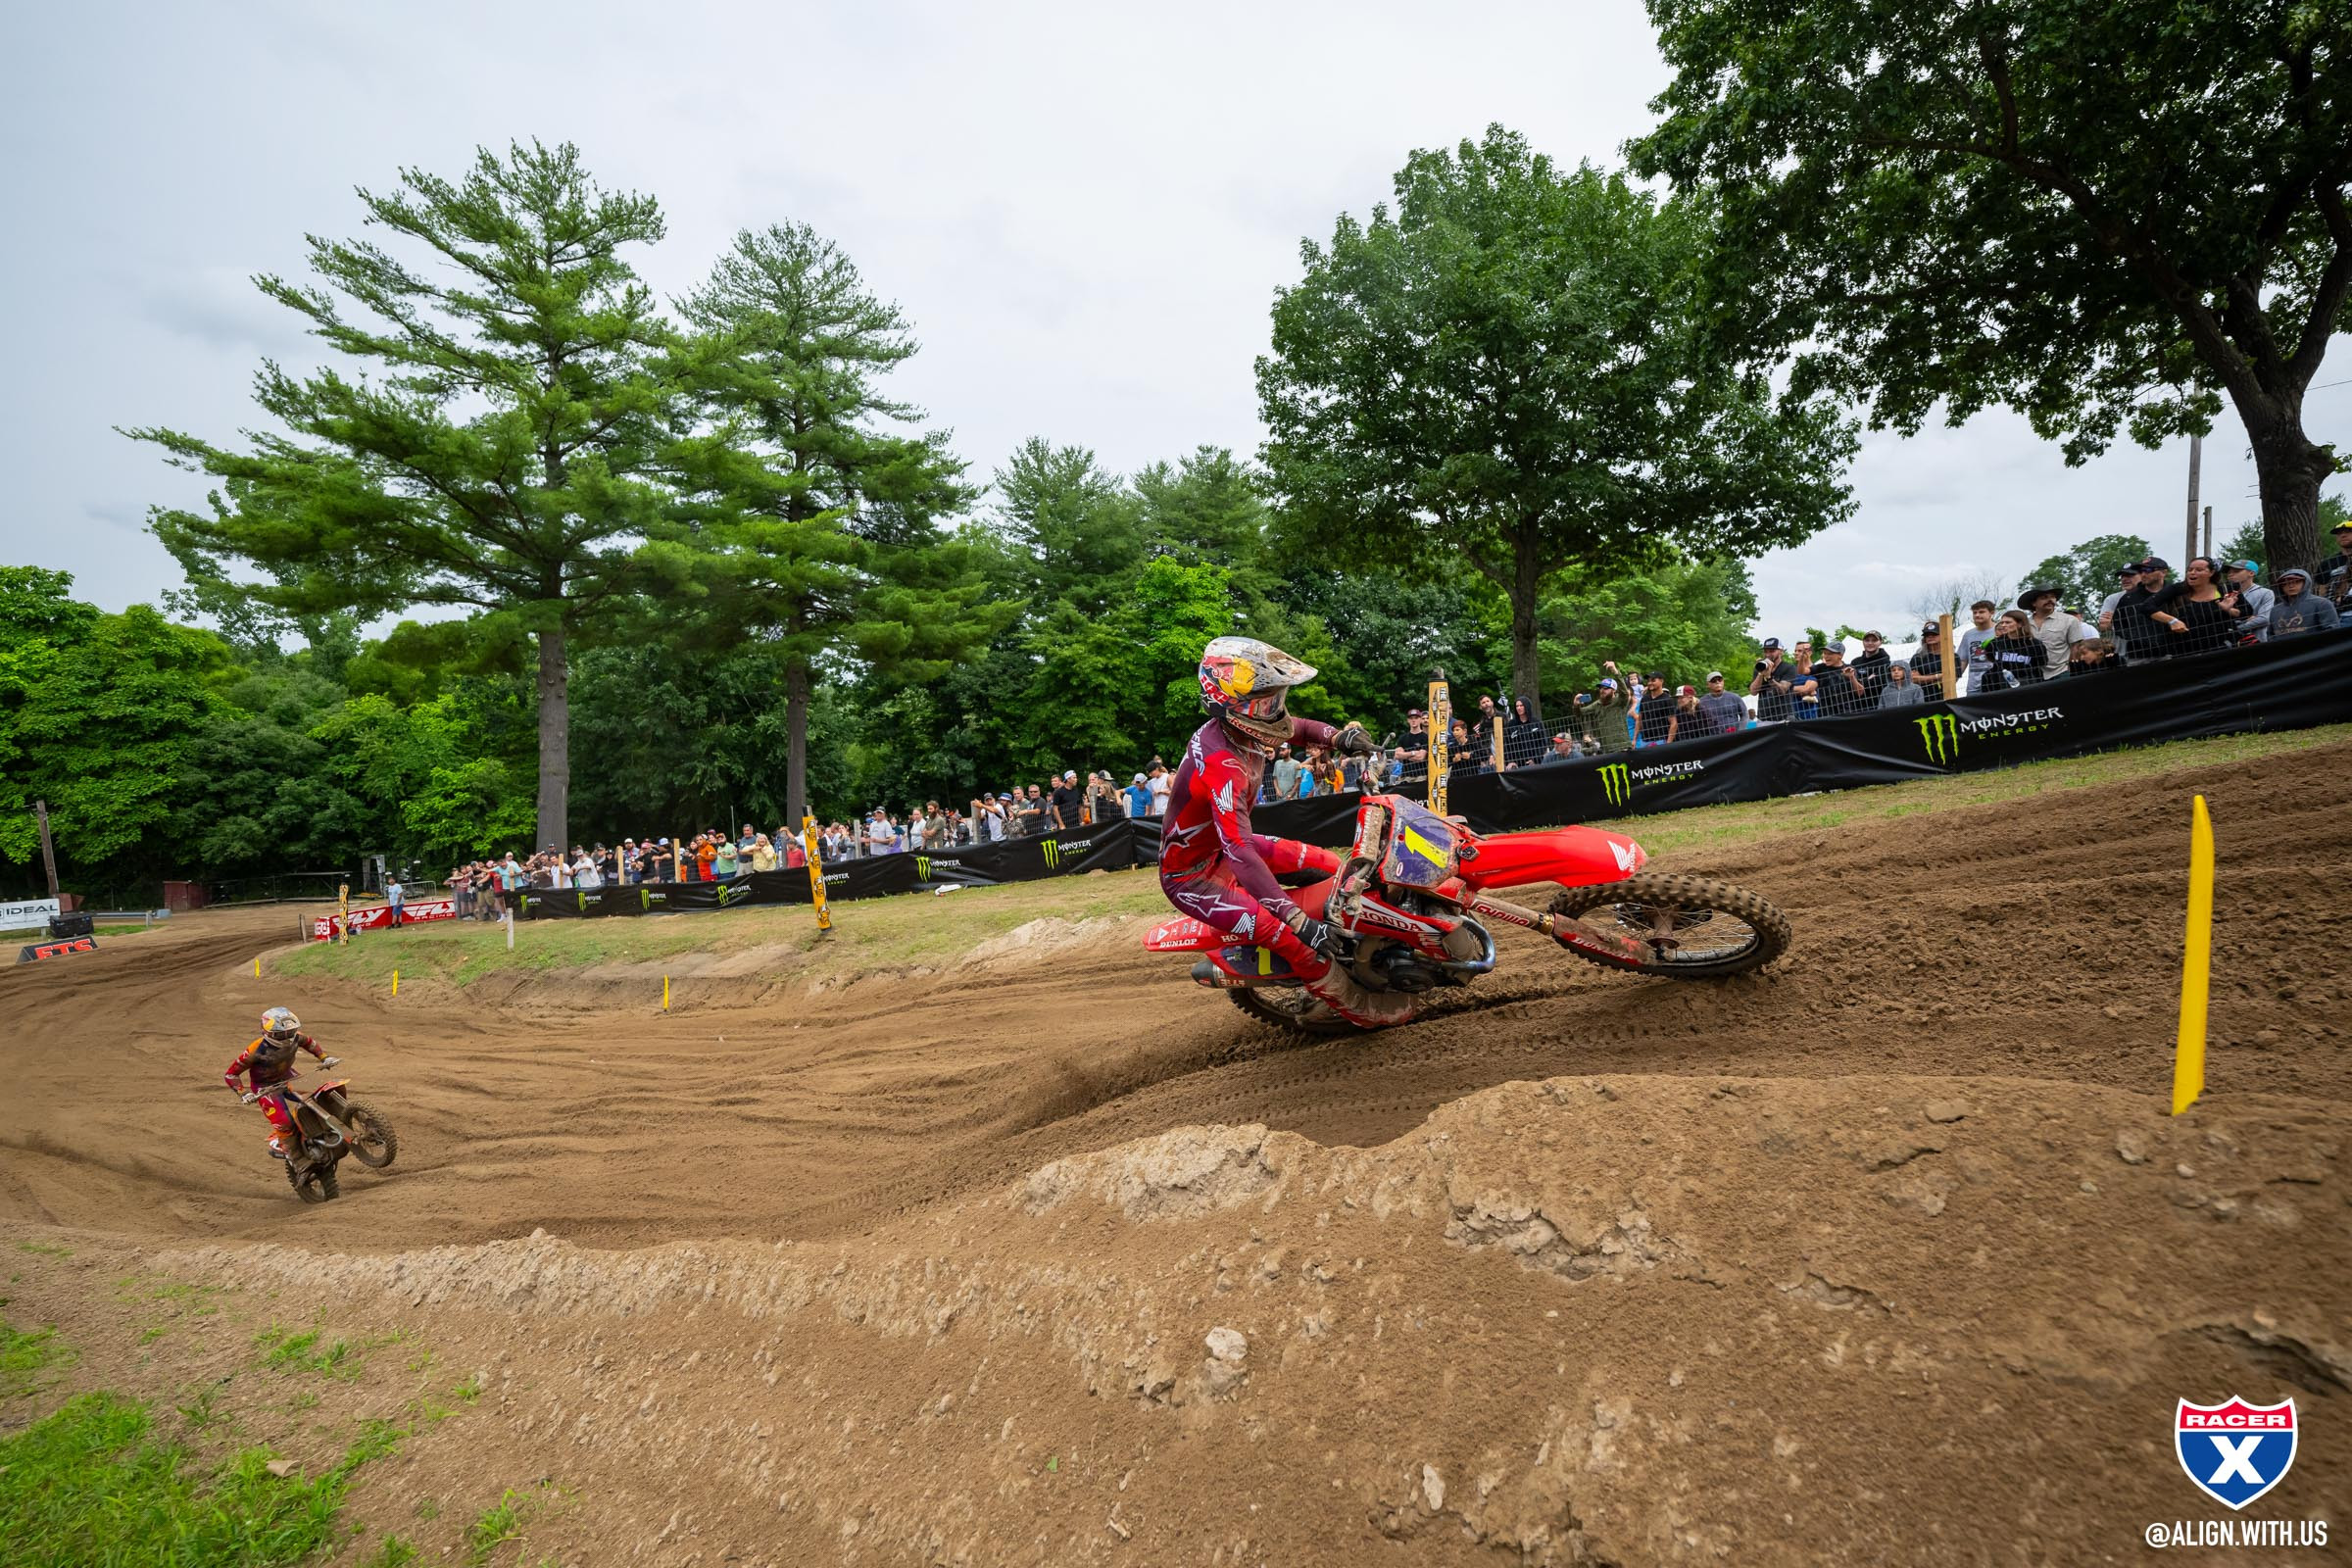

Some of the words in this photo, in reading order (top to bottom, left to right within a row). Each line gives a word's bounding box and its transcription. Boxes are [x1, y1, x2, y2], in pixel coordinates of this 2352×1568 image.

[1960, 707, 2065, 733] MONSTER
[1978, 723, 2049, 740] ENERGY
[1438, 744, 1447, 768] WICK
[1631, 760, 1704, 779] MONSTER
[1643, 773, 1694, 785] ENERGY
[1438, 787, 1447, 812] WICK
[1057, 839, 1092, 852] MONSTER
[1404, 825, 1449, 869] 1
[6, 905, 59, 915] IDEAL
[1158, 938, 1198, 949] DUNLOP
[1255, 946, 1274, 975] 1
